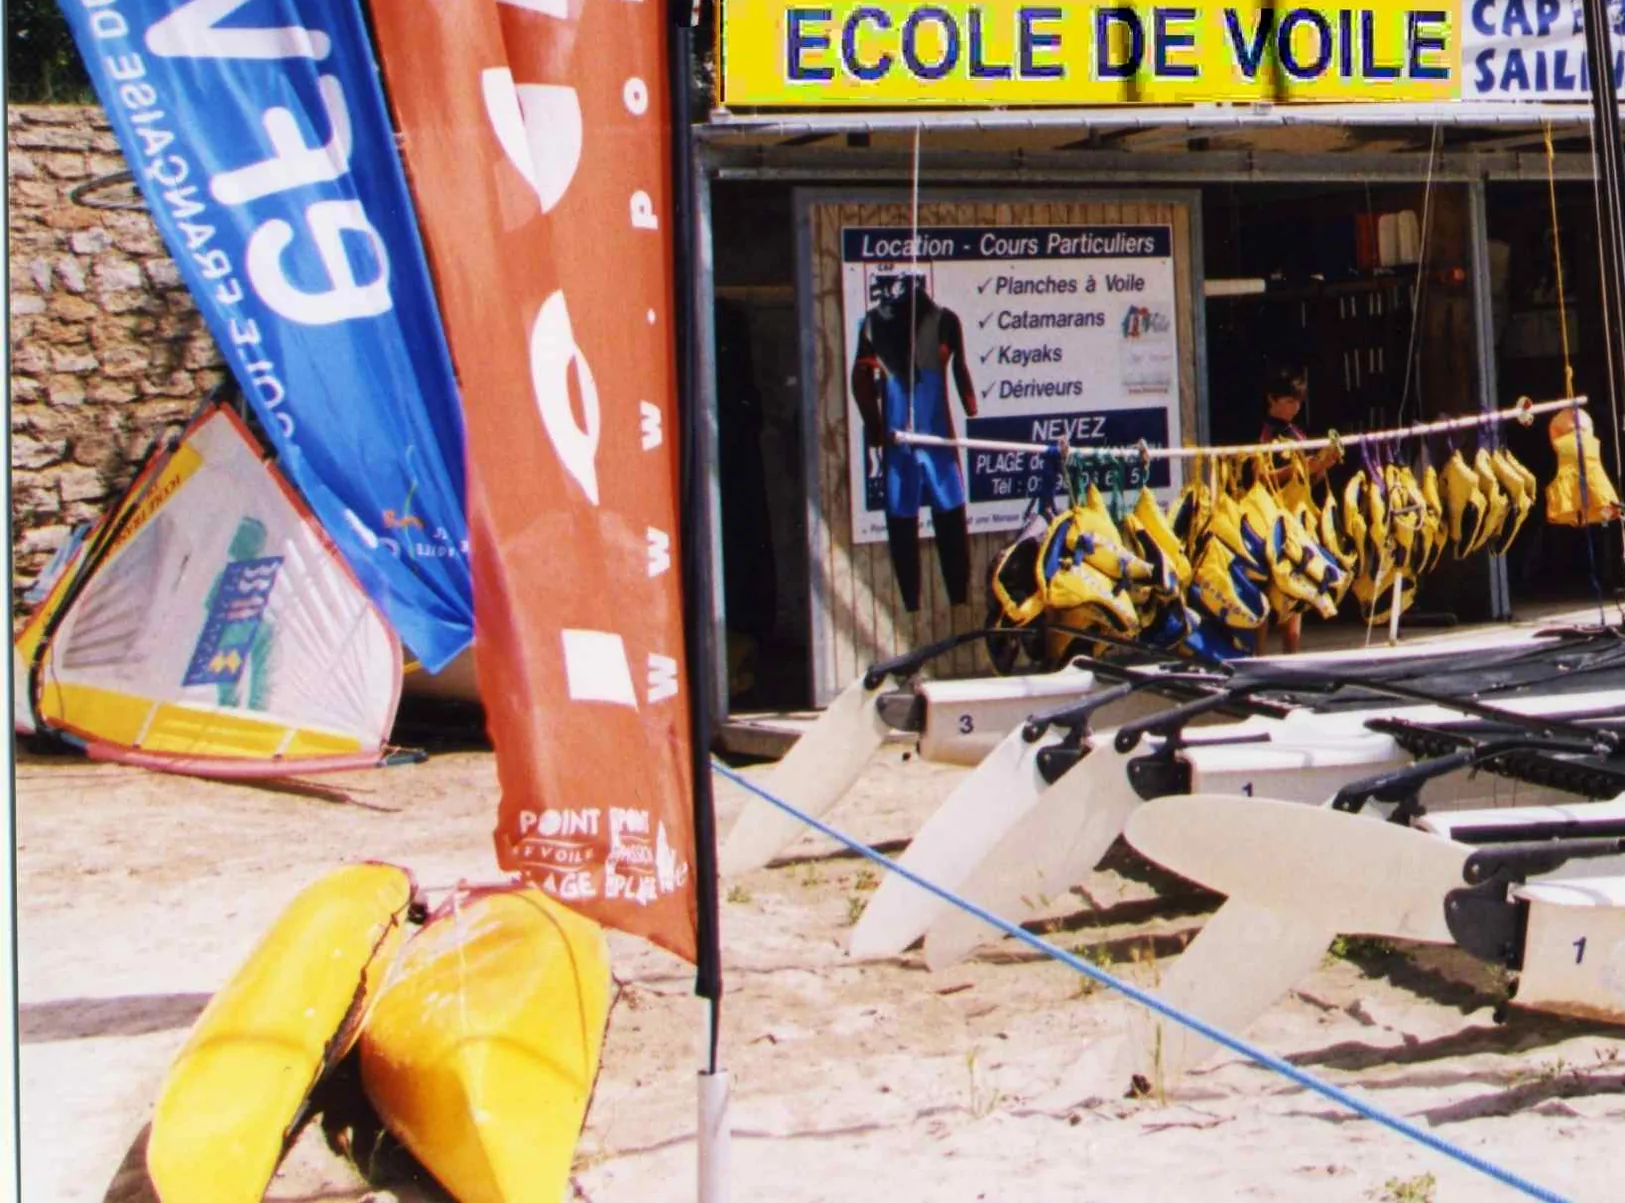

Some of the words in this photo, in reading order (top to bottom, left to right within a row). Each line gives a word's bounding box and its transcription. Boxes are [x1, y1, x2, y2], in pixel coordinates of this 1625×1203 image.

[784, 5, 1066, 82] ECOLE
[1093, 5, 1200, 82] DE
[1223, 5, 1453, 82] VOILE
[861, 234, 954, 258] Location
[980, 232, 1039, 256] Cours
[1046, 233, 1155, 255] Particuliers
[995, 275, 1078, 296] Planches
[1085, 275, 1096, 291] à
[1105, 274, 1145, 292] Voile
[998, 310, 1106, 331] Catamarans
[998, 345, 1063, 366] Kayaks
[1000, 380, 1084, 400] Dériveurs
[1031, 417, 1107, 442] NEVEZ
[976, 451, 1025, 474] PLAGE
[991, 478, 1012, 495] Tél
[959, 714, 974, 734] 3
[519, 807, 601, 836] POINT
[1571, 936, 1587, 965] 1
